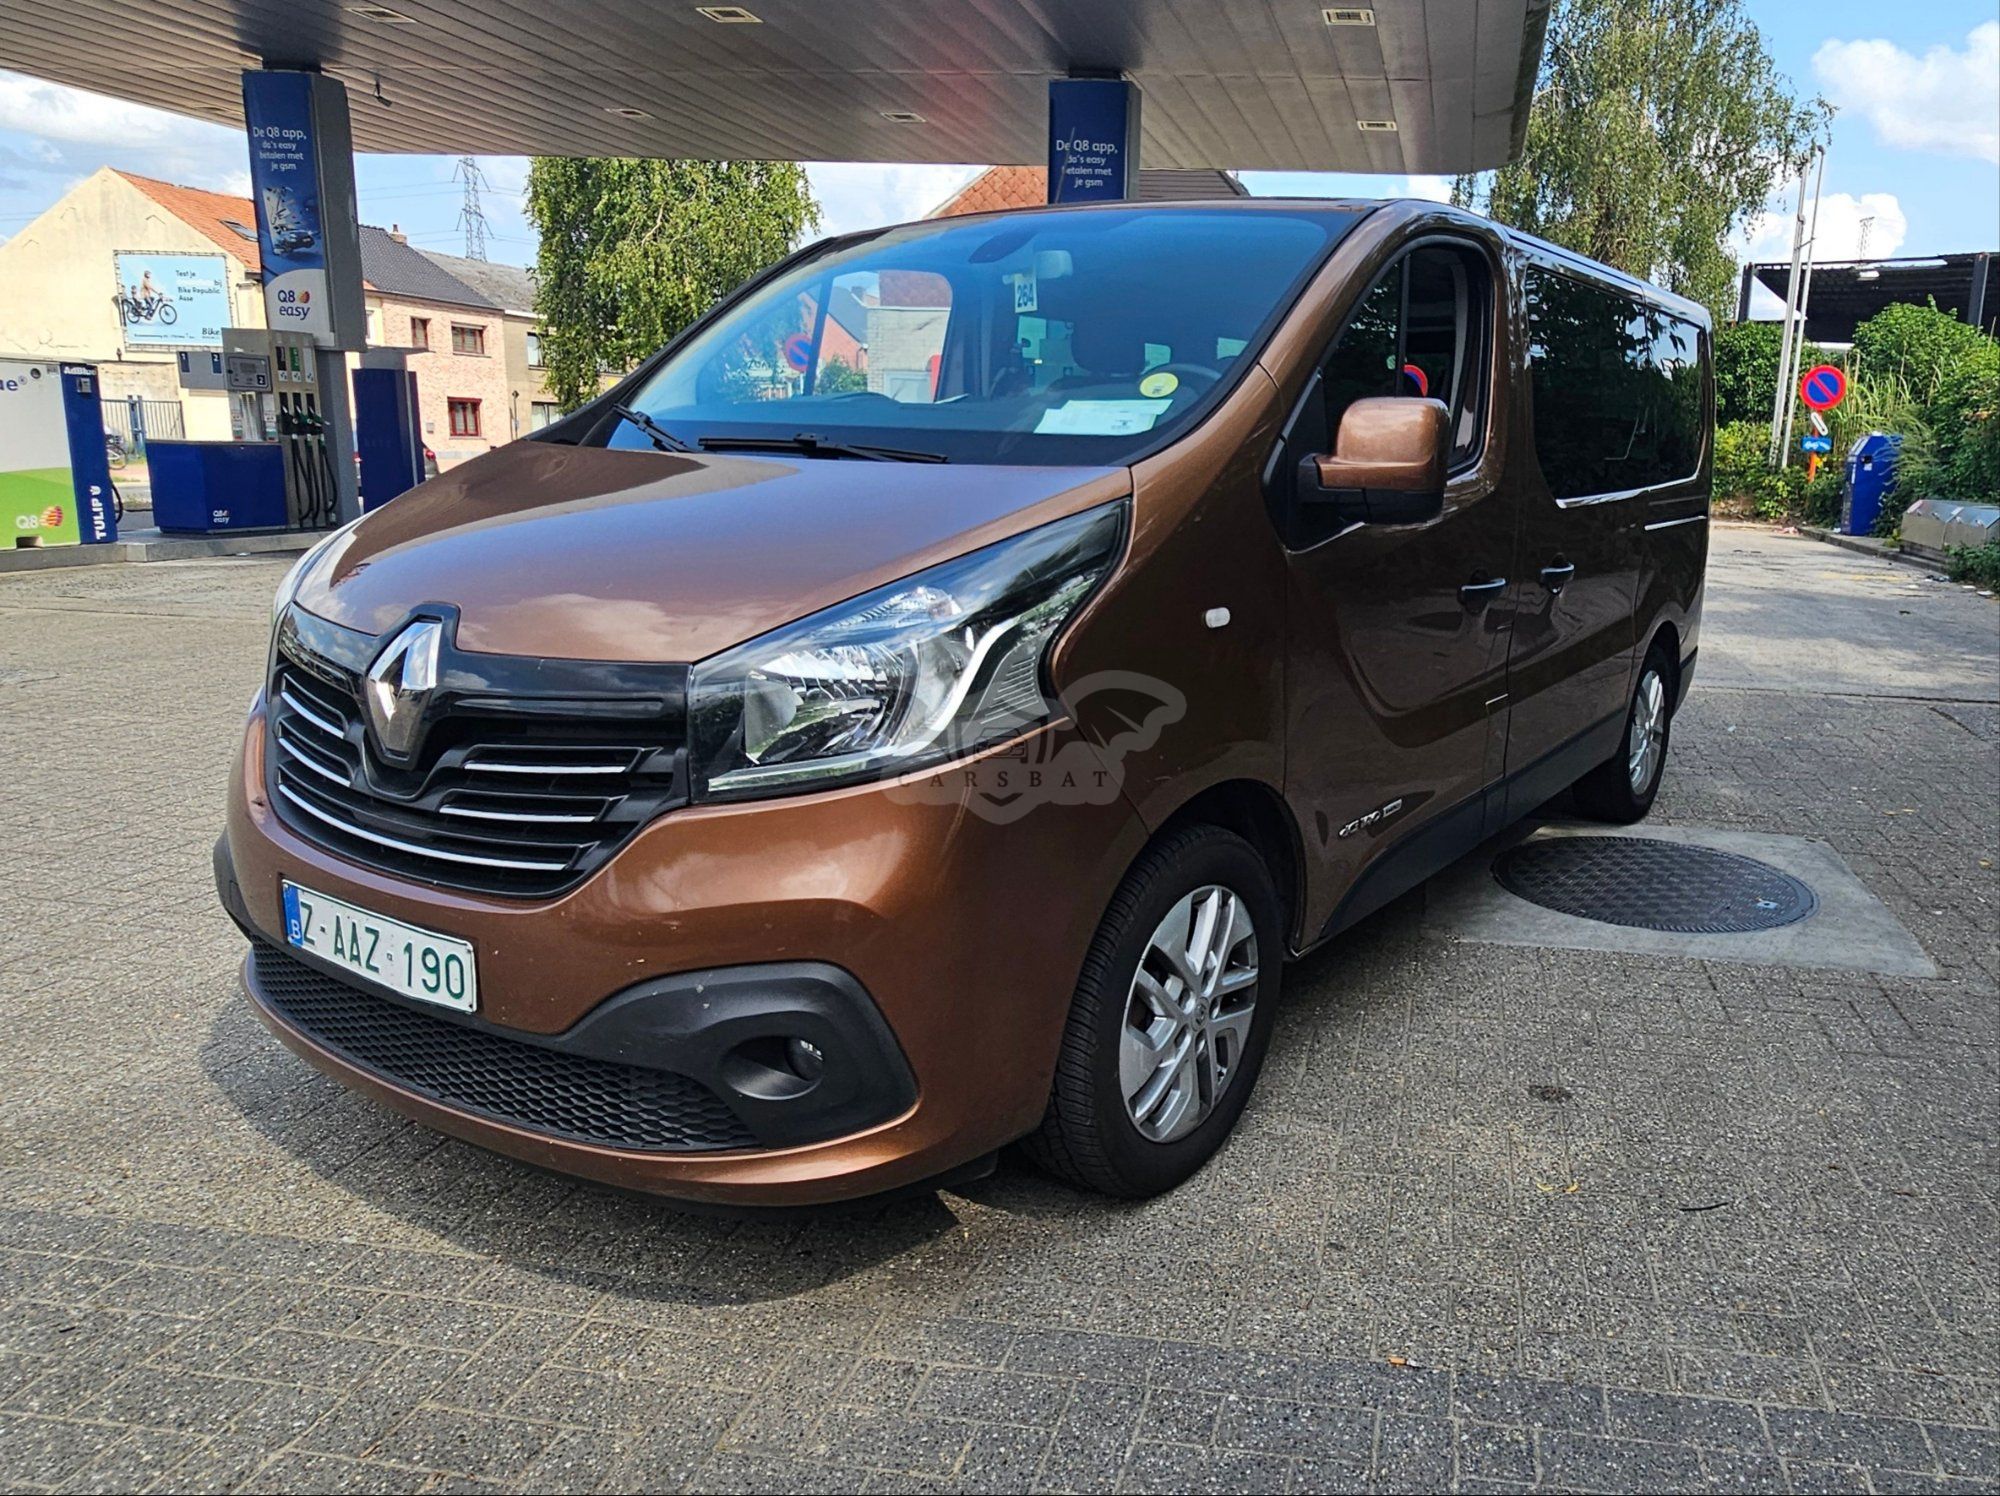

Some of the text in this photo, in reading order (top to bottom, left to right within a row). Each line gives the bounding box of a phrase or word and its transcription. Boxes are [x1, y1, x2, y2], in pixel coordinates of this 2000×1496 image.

[253, 126, 307, 140] De Q8 app,
[278, 143, 297, 151] easy
[1056, 139, 1118, 155] De Q8 app,
[259, 150, 304, 160] betalen met
[1086, 156, 1106, 166] easy
[279, 163, 297, 172] gsm
[1094, 168, 1112, 176] met
[1074, 176, 1103, 188] je gsm
[277, 289, 296, 303] Q8
[279, 305, 310, 321] easy
[258, 376, 266, 386] 2
[16, 515, 39, 529] Q8
[91, 497, 107, 540] TULIP
[291, 919, 301, 940] B
